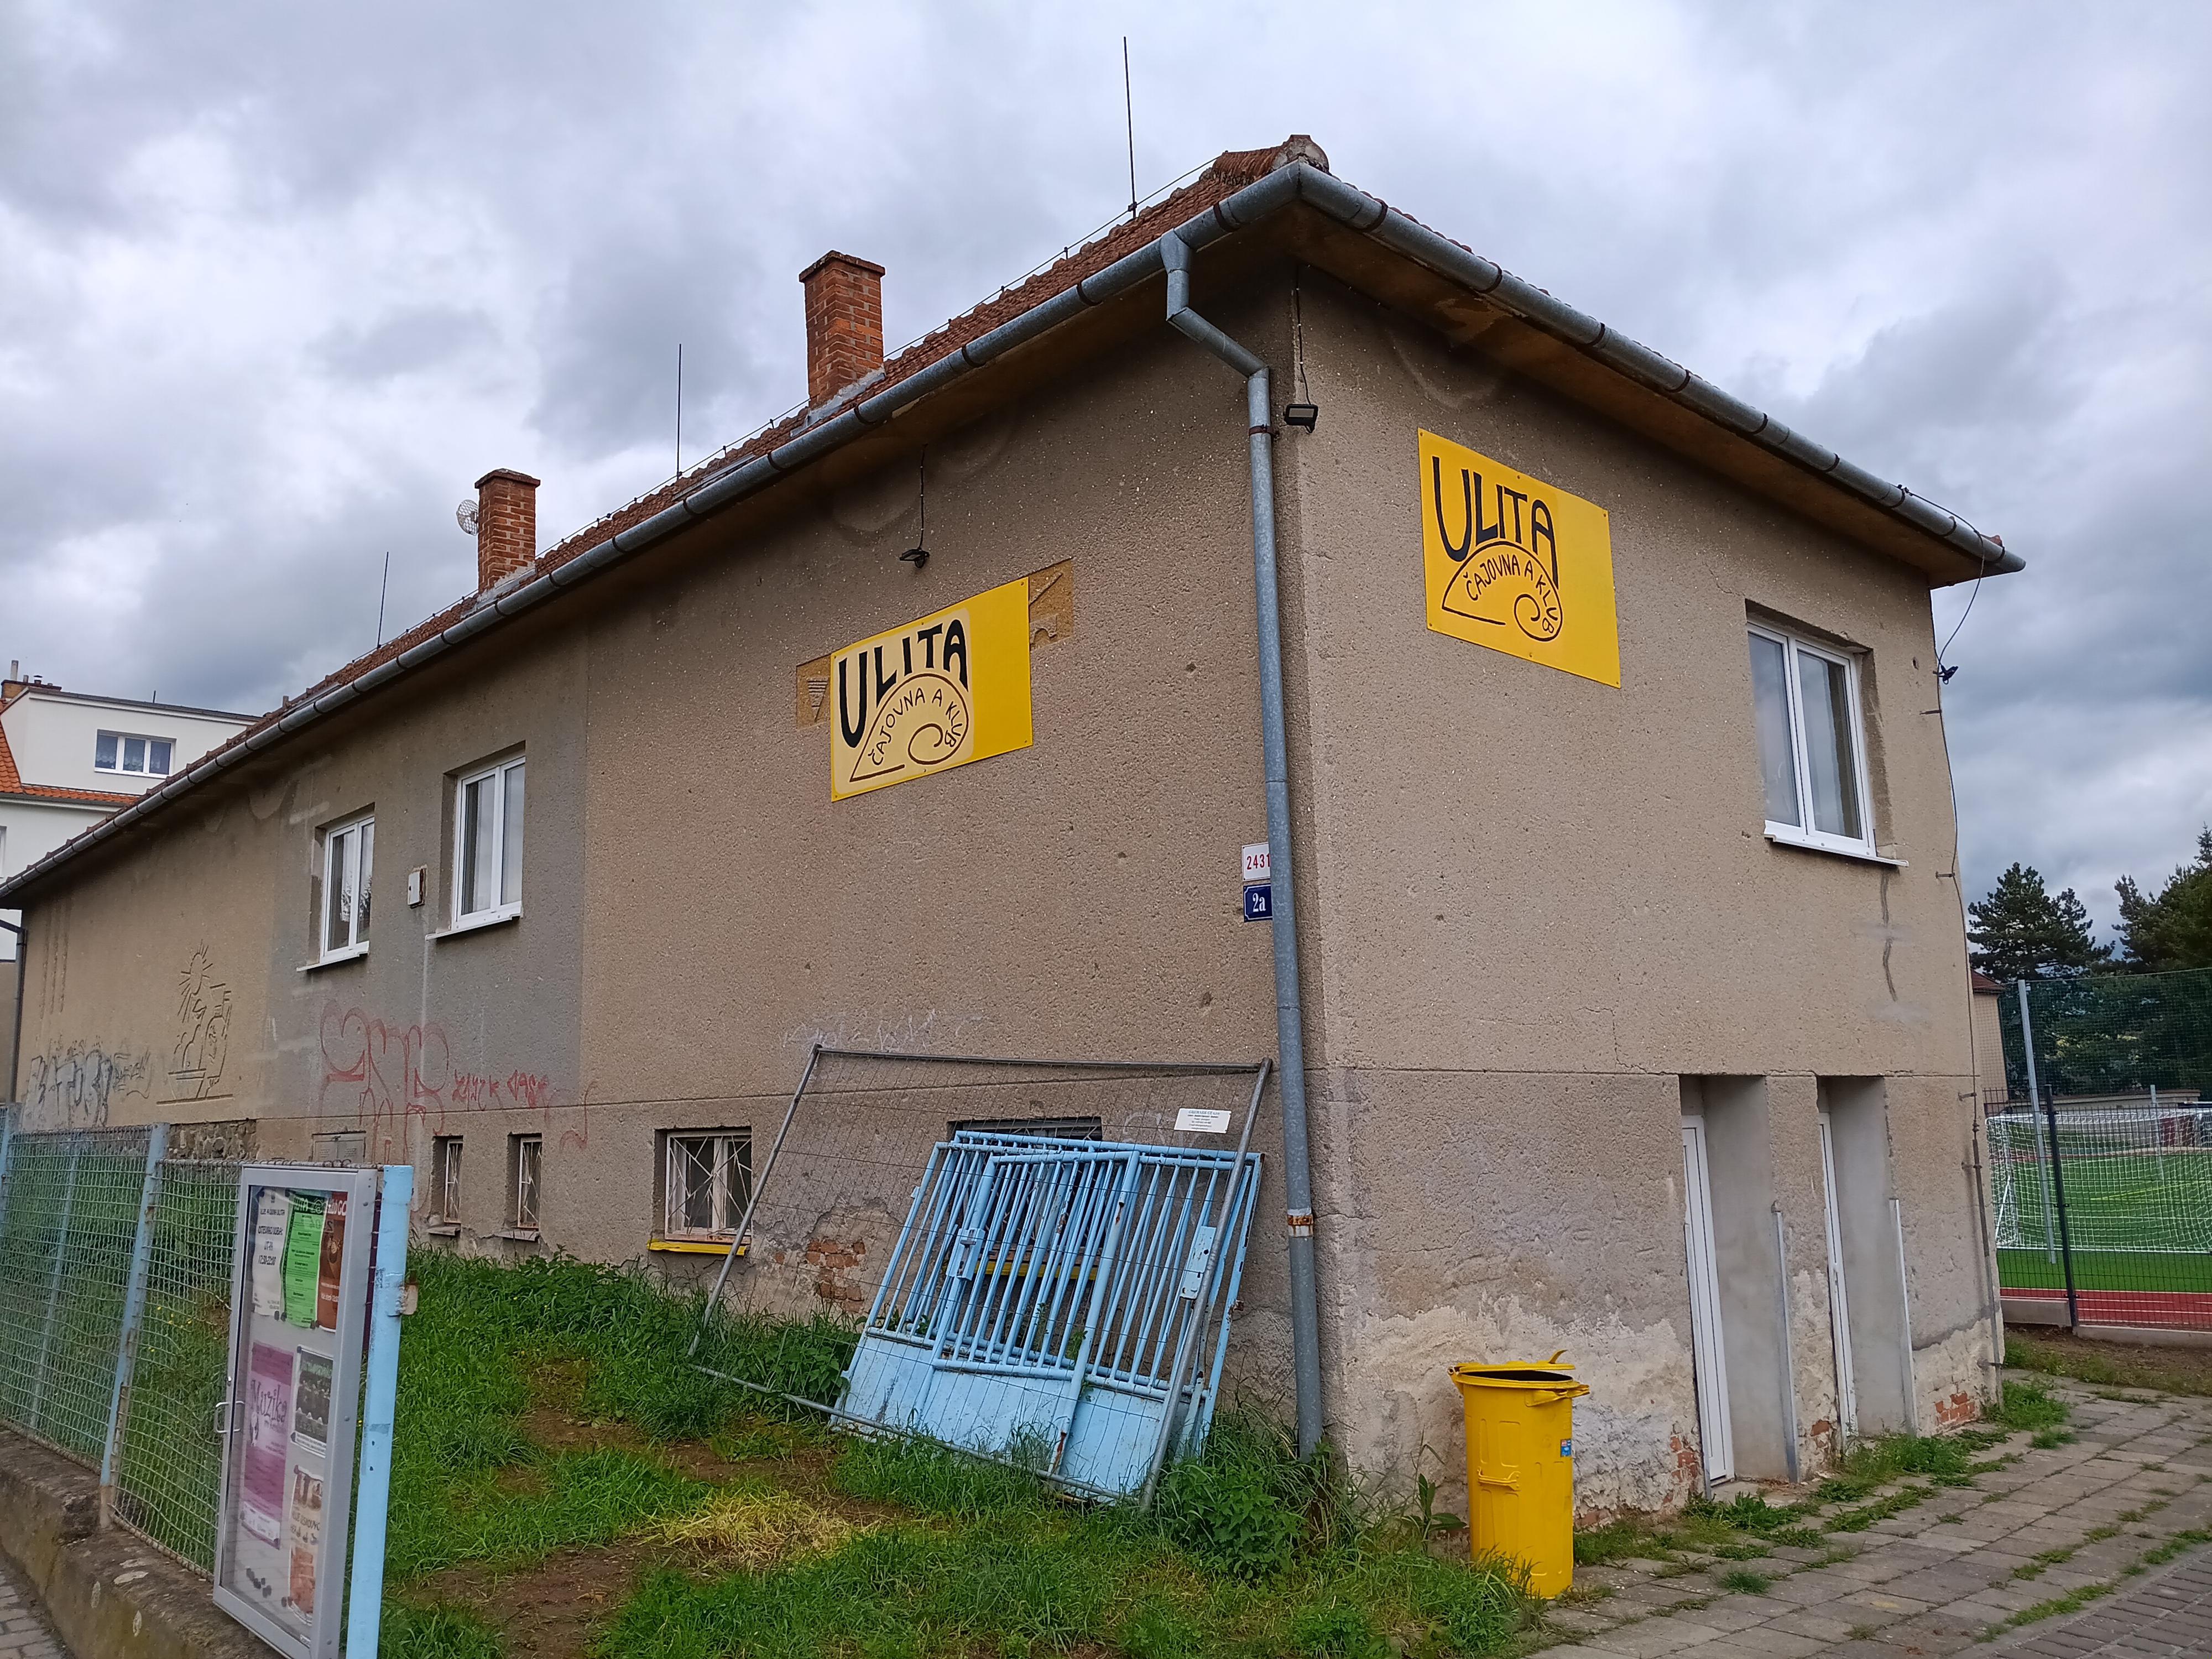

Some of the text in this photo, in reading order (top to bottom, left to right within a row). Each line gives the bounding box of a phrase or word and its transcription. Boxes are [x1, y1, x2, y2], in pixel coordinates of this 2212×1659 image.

[1432, 456, 1559, 590] ULITA
[1463, 553, 1558, 634] ČAJOVNA A KLUB
[838, 619, 969, 748] ULITA
[868, 687, 963, 766] ČAJOVNA A KLUB
[1246, 853, 1271, 870] 2431
[1253, 893, 1266, 912] 2a
[251, 1379, 288, 1423] Muzika
